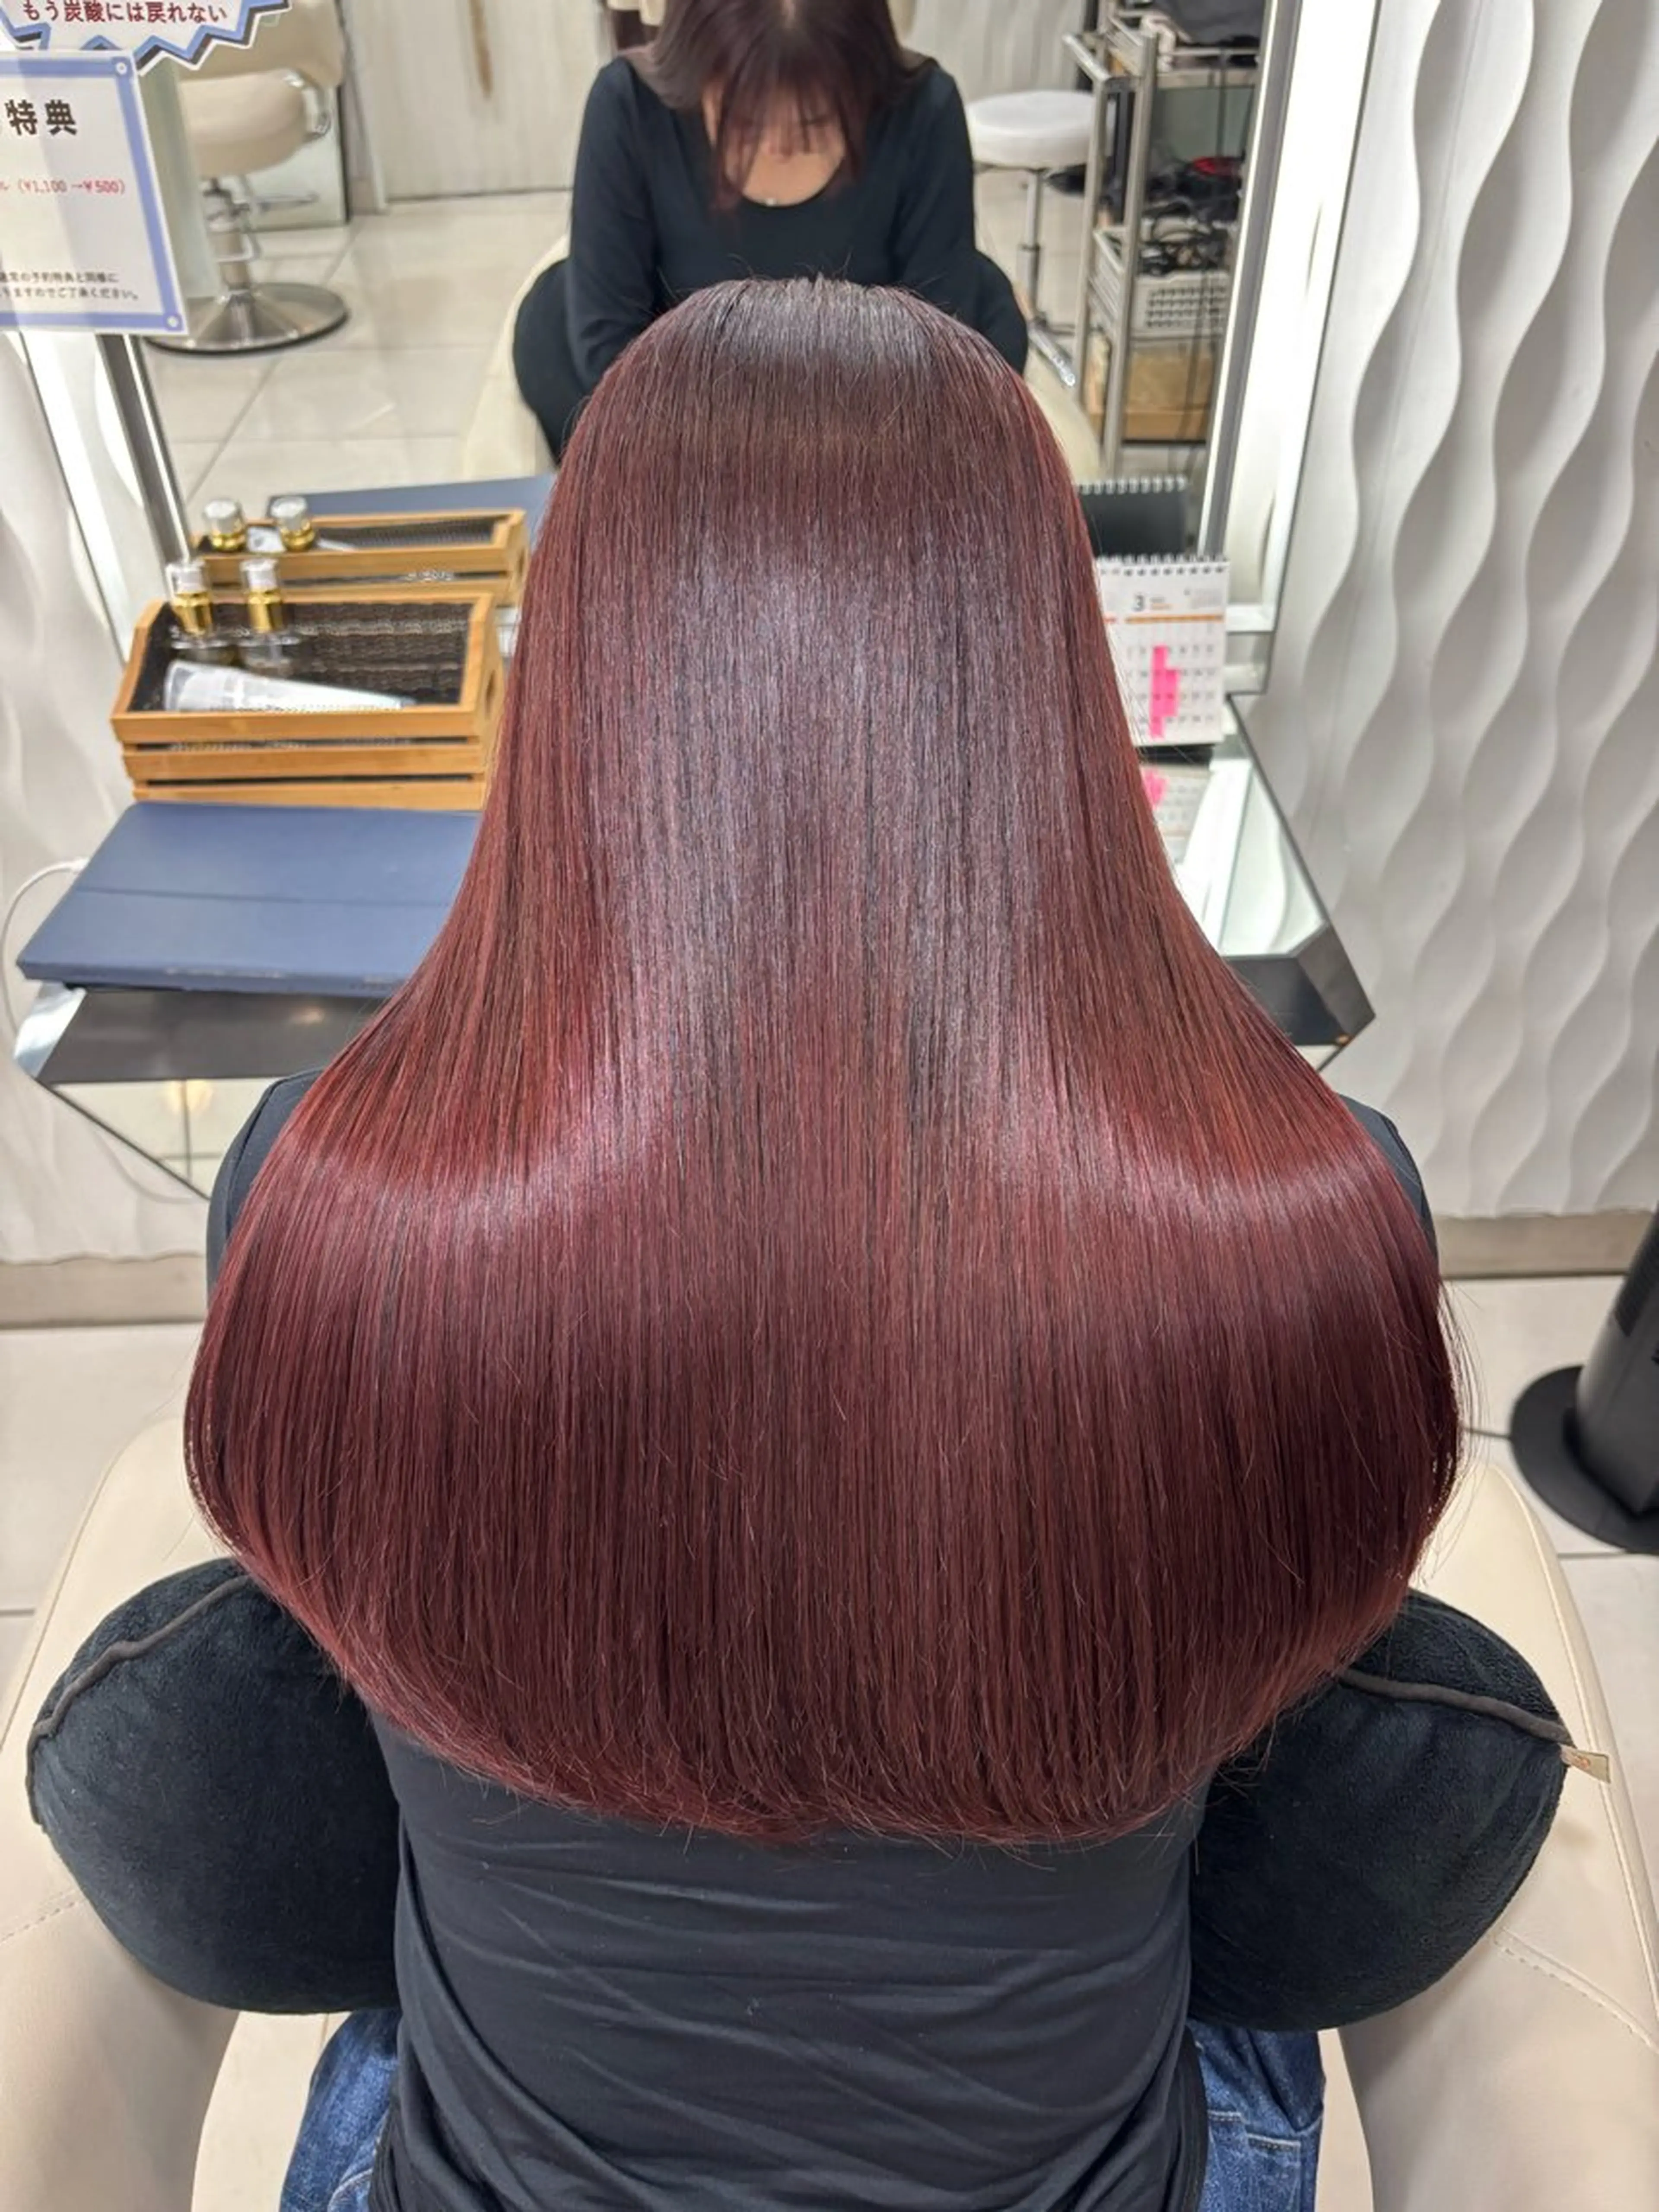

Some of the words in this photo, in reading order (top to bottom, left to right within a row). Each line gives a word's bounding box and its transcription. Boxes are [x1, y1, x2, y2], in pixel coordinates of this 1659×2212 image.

[23, 0, 227, 23] もう炭酸には戻れない
[4, 99, 77, 136] 特典
[1132, 593, 1145, 612] 3
